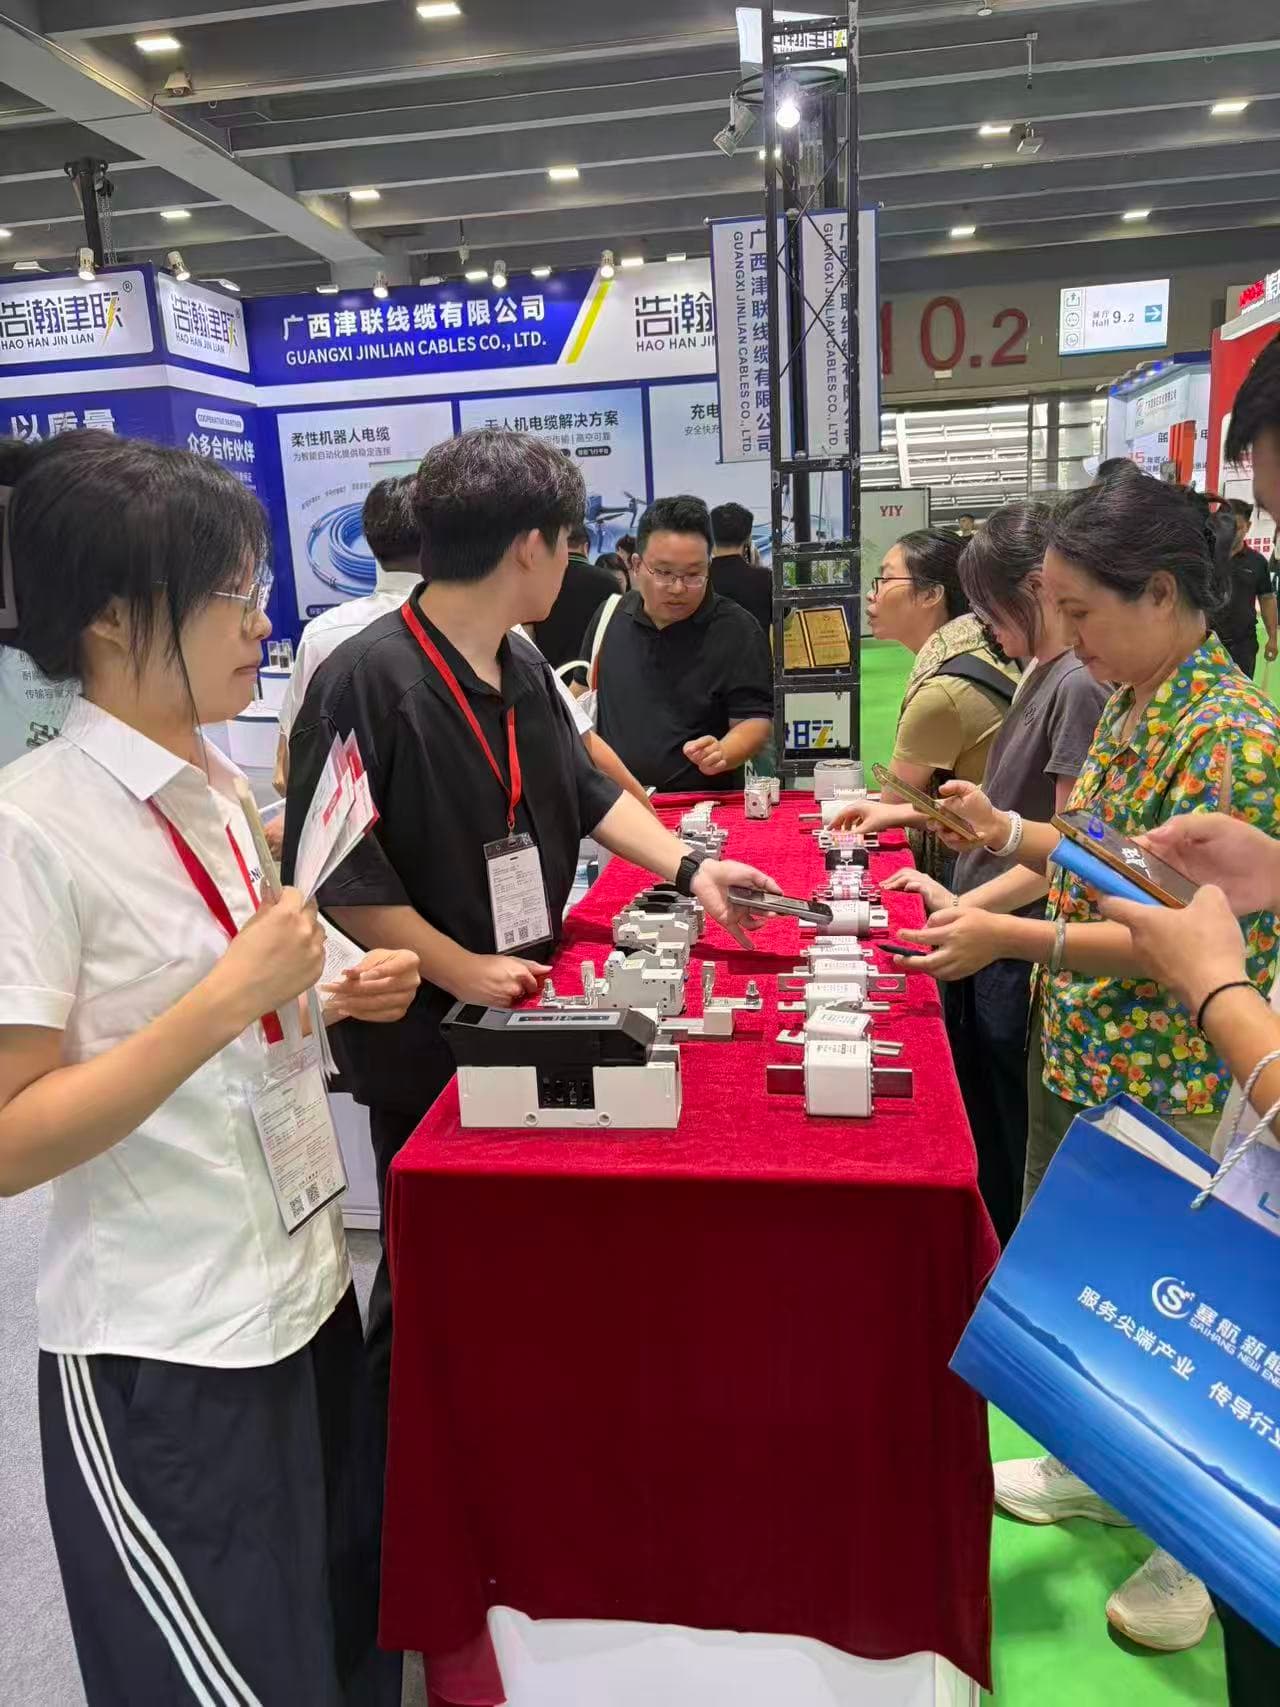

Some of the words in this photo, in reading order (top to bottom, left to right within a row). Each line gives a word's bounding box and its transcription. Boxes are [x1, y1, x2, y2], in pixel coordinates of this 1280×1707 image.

[733, 231, 745, 291] GUANGXI
[283, 294, 545, 341] 广西津联线缆有限公司
[634, 292, 713, 337] 浩瀚
[736, 295, 748, 344] JINLIAN
[881, 296, 1029, 376] 10.2
[1092, 318, 1110, 328] Hall
[1112, 310, 1135, 324] 9.2
[1, 338, 24, 350] HAO
[27, 336, 48, 349] HAN
[53, 335, 68, 346] JIN
[72, 333, 95, 345] LIAN
[175, 332, 189, 344] HAO
[286, 346, 353, 366] GUANGXI
[356, 340, 415, 361] JINLIAN
[417, 336, 477, 356] CABLES
[479, 334, 511, 352] CO.,
[514, 331, 547, 348] LTD.
[636, 340, 665, 352] HAO
[669, 336, 697, 350] HAN
[739, 347, 750, 398] CABLES
[826, 341, 837, 392] CABLES
[187, 432, 256, 464] 众多合作伙伴
[291, 426, 391, 448] 柔性机器人电缆
[742, 429, 753, 455] LTD.
[1077, 1285, 1197, 1382] 服务尖端产业
[1188, 1316, 1237, 1357] SAIHANG
[1237, 1351, 1263, 1373] NEW
